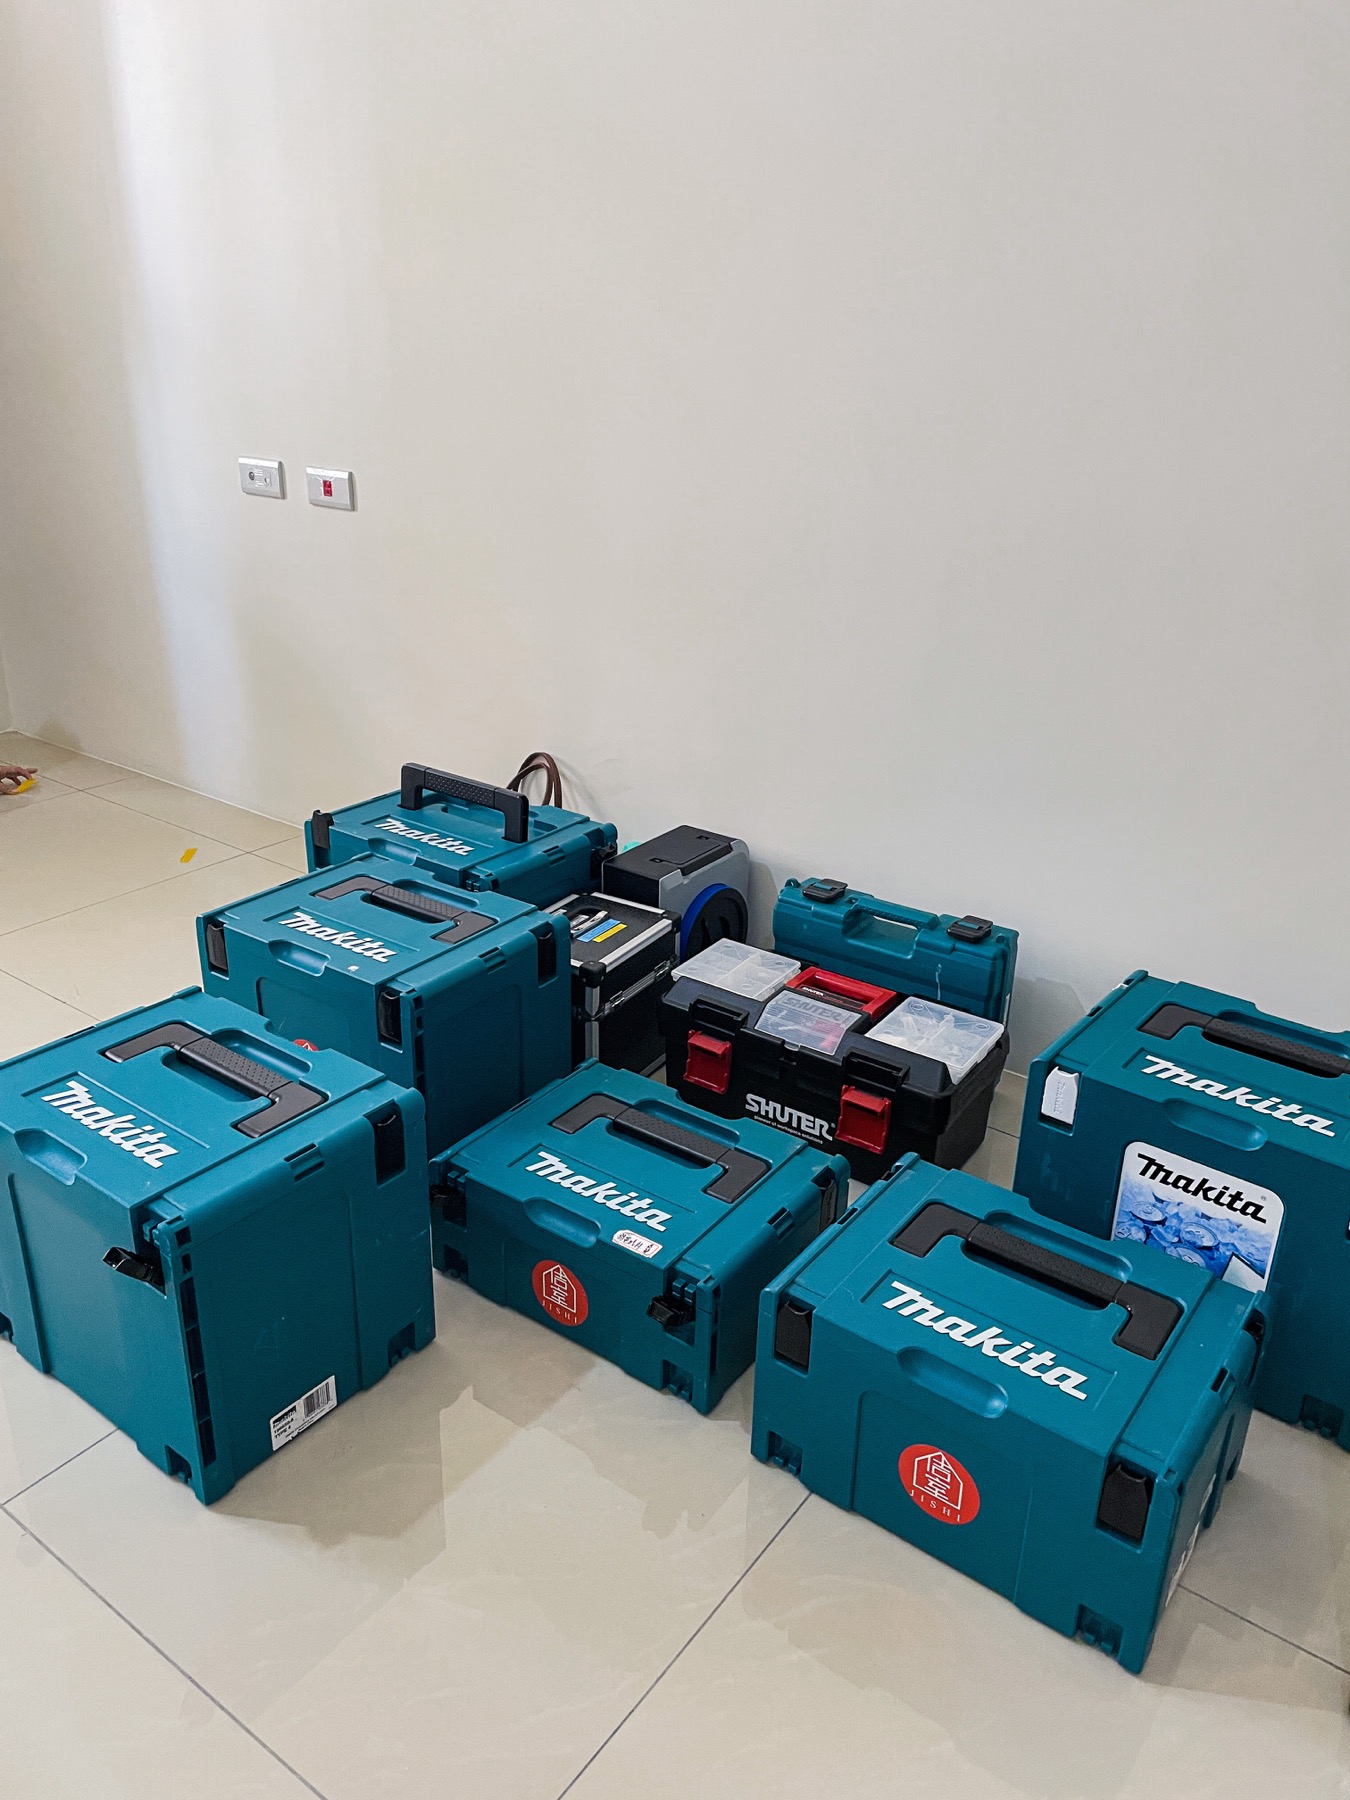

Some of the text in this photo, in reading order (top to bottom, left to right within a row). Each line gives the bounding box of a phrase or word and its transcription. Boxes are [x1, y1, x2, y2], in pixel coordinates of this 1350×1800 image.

[782, 997, 842, 1020] SHUTER
[745, 1093, 833, 1141] SHUTER
[542, 1300, 577, 1324] JISHI
[909, 1489, 960, 1522] JISHI
